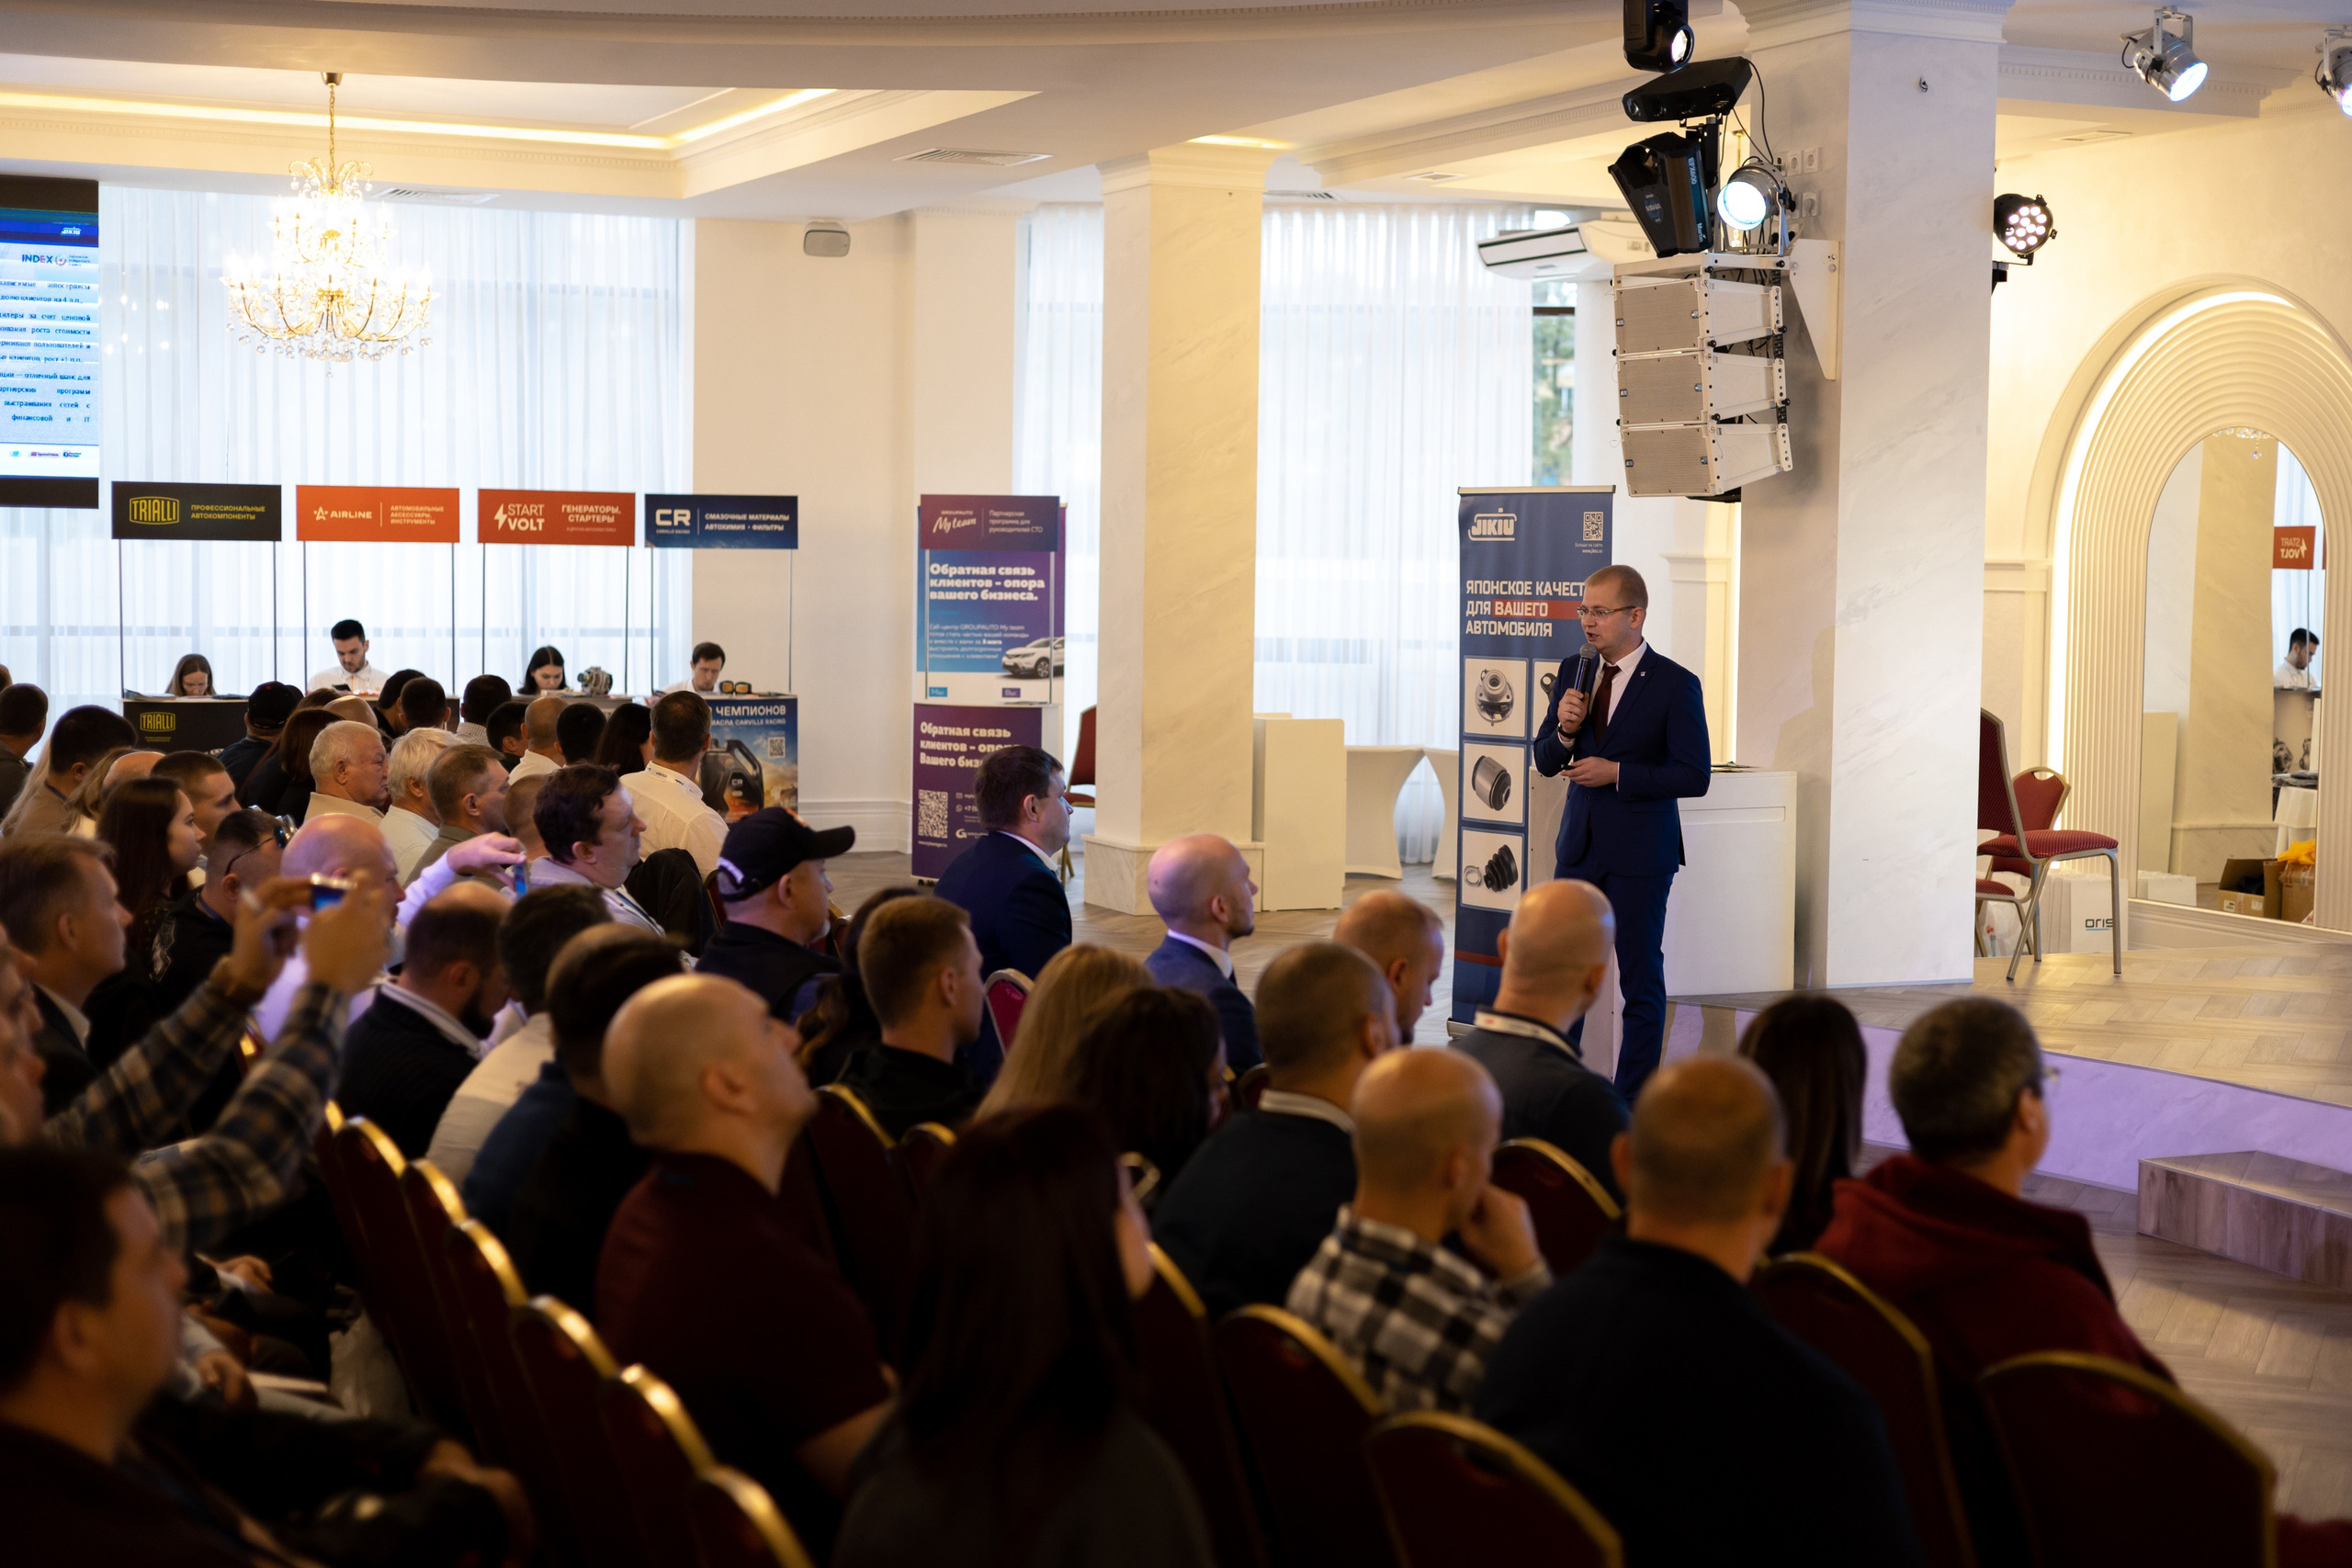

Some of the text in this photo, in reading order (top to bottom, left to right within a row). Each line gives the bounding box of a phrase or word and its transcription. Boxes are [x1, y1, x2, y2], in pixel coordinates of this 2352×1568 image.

[1688, 157, 1698, 185] EFX600
[22, 254, 53, 264] INDEX
[132, 500, 176, 523] TRIALLI
[191, 504, 266, 513] ПРОФЕССИОНАЛЬНЫЕ
[331, 511, 372, 520] AIRLINE
[507, 503, 545, 516] START
[561, 504, 621, 515] ГЕНЕРАТОРЫ,
[989, 509, 1024, 517] Партнерская
[507, 518, 545, 531] VOLT
[568, 514, 615, 524] СТАРТЕРЫ
[655, 509, 691, 526] CR
[1472, 519, 1514, 536] JIKIU
[930, 563, 1035, 578] Обратная связь
[930, 578, 993, 589] клиентов
[1003, 580, 1046, 592] опора
[1466, 581, 1586, 597] ЯПОНСКОЕ КАЧЕСТ
[930, 590, 1038, 602] вашего бизнеса.
[1465, 601, 1548, 616] ДЛЯ ВАШЕГО
[1465, 620, 1552, 637] АВТОМОБИЛЯ
[716, 705, 786, 716] ЧЕМПИОНОВ
[141, 714, 174, 729] TRIALLI
[765, 717, 786, 726] RACING
[921, 721, 1012, 738] Обратная связь
[920, 739, 967, 751] клиентов
[978, 743, 1021, 753] опо
[920, 752, 983, 768] Вашего биз
